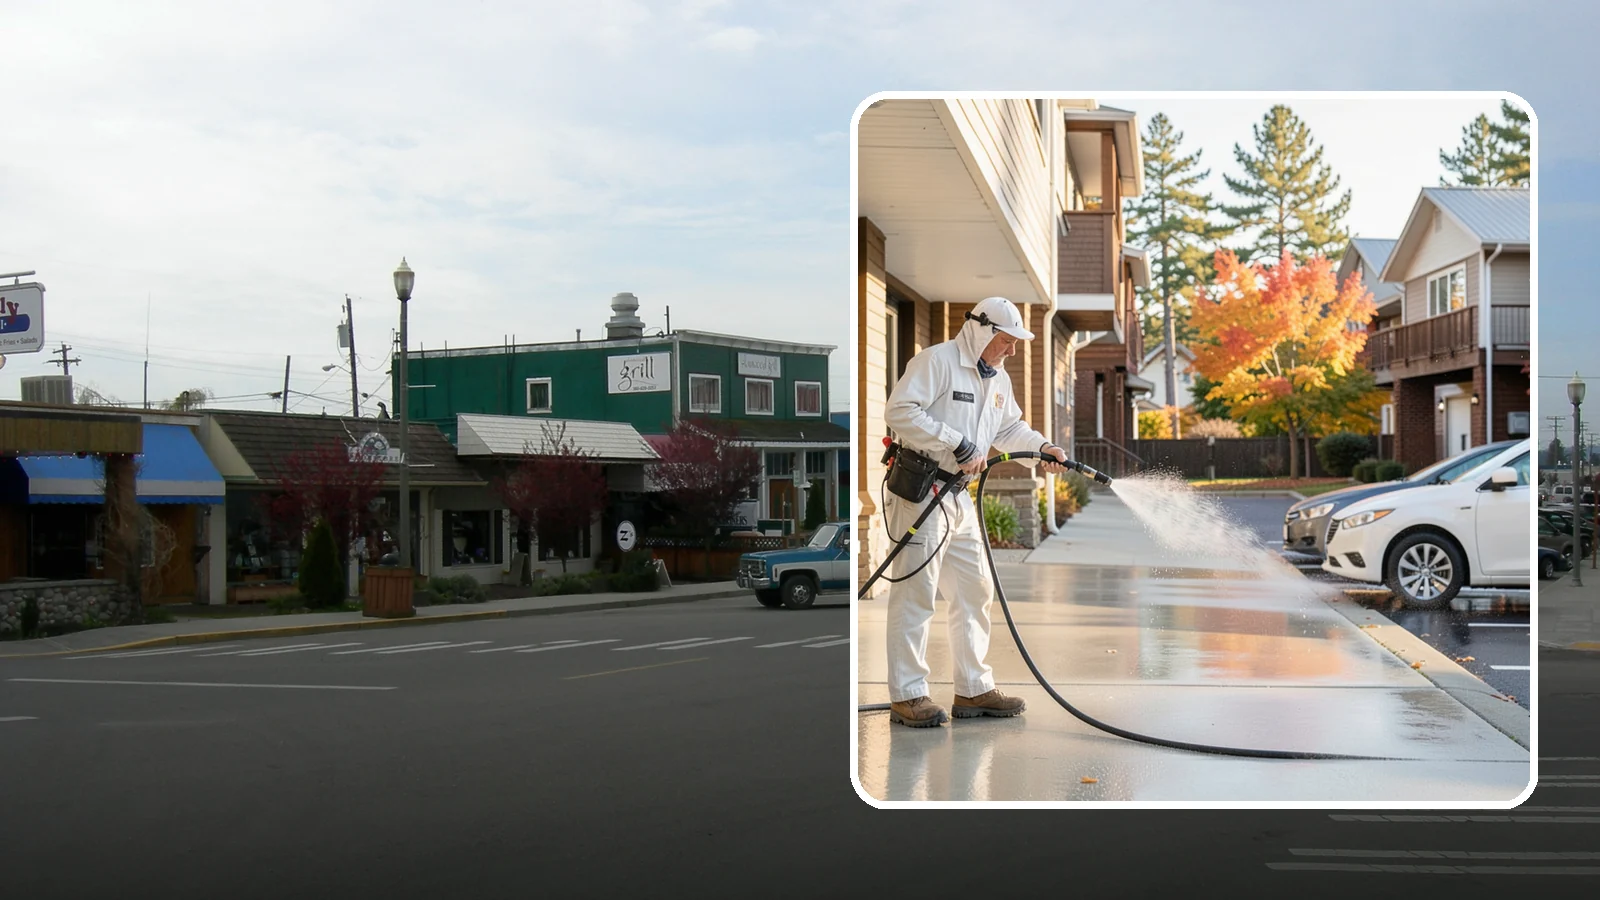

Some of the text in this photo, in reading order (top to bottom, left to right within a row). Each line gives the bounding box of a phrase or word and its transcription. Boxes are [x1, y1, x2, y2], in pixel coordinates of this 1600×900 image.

[3, 338, 16, 346] Fries
[20, 336, 38, 345] Salads
[618, 356, 655, 392] grill
